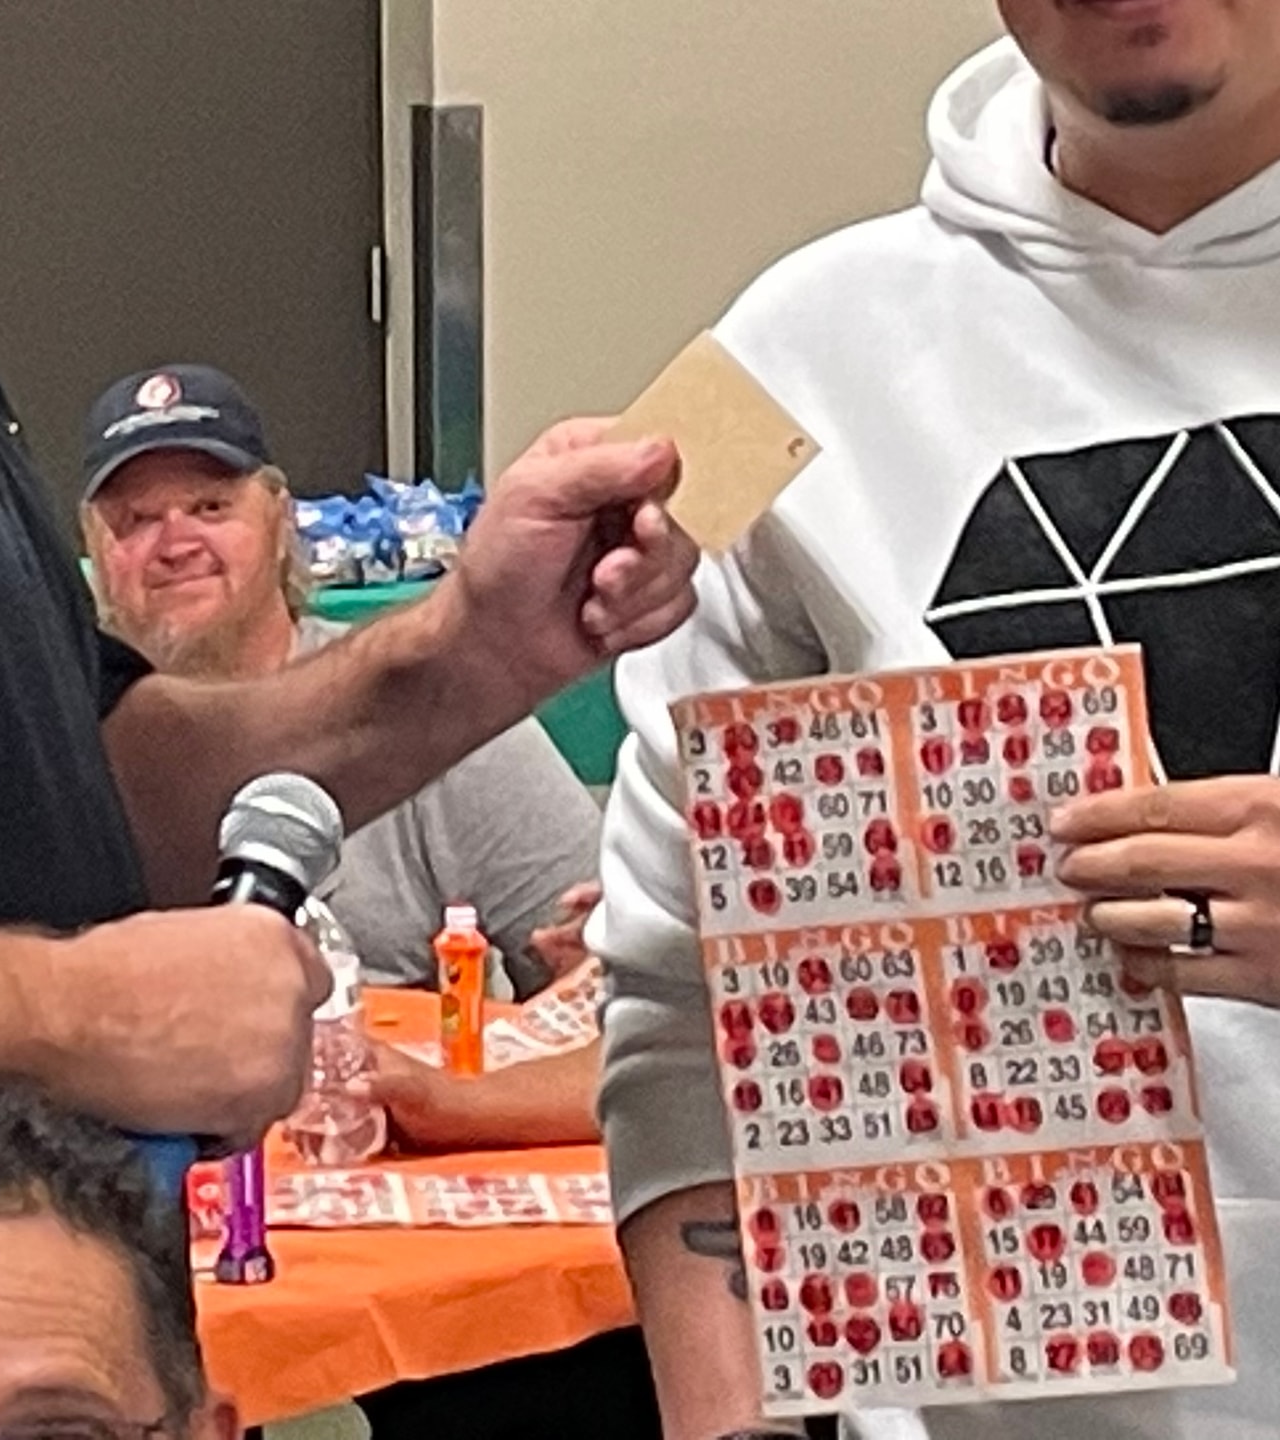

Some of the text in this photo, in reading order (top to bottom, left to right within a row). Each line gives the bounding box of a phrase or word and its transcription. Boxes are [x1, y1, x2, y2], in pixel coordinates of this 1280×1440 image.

[921, 703, 937, 732] 3
[1083, 686, 1117, 714] 69
[689, 729, 706, 756] 3
[850, 711, 879, 739] 61
[1043, 730, 1075, 758] 58
[694, 770, 711, 793] 2
[775, 759, 804, 785] 42
[923, 782, 953, 809] 10
[963, 777, 995, 806] 30
[1048, 770, 1079, 797] 60
[818, 793, 848, 820] 60
[857, 790, 886, 815] 71
[968, 818, 1000, 844] 26
[1009, 814, 1043, 840] 33
[701, 846, 727, 870] 12
[935, 862, 962, 887] 12
[976, 857, 1006, 883] 16
[710, 883, 727, 910] 5
[786, 875, 817, 902] 39
[827, 872, 858, 897] 54
[954, 945, 966, 972] 1
[1030, 936, 1064, 965] 39
[722, 967, 739, 993] 3
[840, 954, 872, 982] 60
[1038, 976, 1069, 1002] 43
[806, 998, 836, 1024] 43
[1128, 1008, 1162, 1033] 73
[895, 1029, 927, 1055] 73
[1005, 1059, 1038, 1085] 22
[1048, 1055, 1080, 1083] 33
[776, 1078, 804, 1106] 16
[1055, 1094, 1087, 1119] 45
[745, 1123, 760, 1148] 2
[777, 1119, 809, 1146] 23
[820, 1115, 852, 1142] 33
[864, 1112, 892, 1139] 51
[1112, 1171, 1144, 1204] 54
[794, 1203, 821, 1230] 16
[989, 1227, 1019, 1254] 15
[1074, 1220, 1106, 1244] 44
[1118, 1215, 1150, 1243] 59
[799, 1243, 826, 1269] 19
[838, 1240, 870, 1265] 42
[880, 1235, 913, 1262] 48
[1039, 1264, 1067, 1289] 19
[1164, 1253, 1194, 1280] 71
[886, 1276, 915, 1303] 57
[1006, 1307, 1022, 1331] 4
[1040, 1303, 1072, 1330] 23
[1083, 1301, 1110, 1326] 31
[1128, 1296, 1159, 1322] 49
[764, 1325, 794, 1352] 10
[933, 1312, 965, 1339] 70
[1010, 1346, 1027, 1376] 8
[1175, 1333, 1208, 1360] 69
[774, 1364, 791, 1391] 3
[854, 1359, 881, 1385] 31
[896, 1356, 921, 1384] 51
